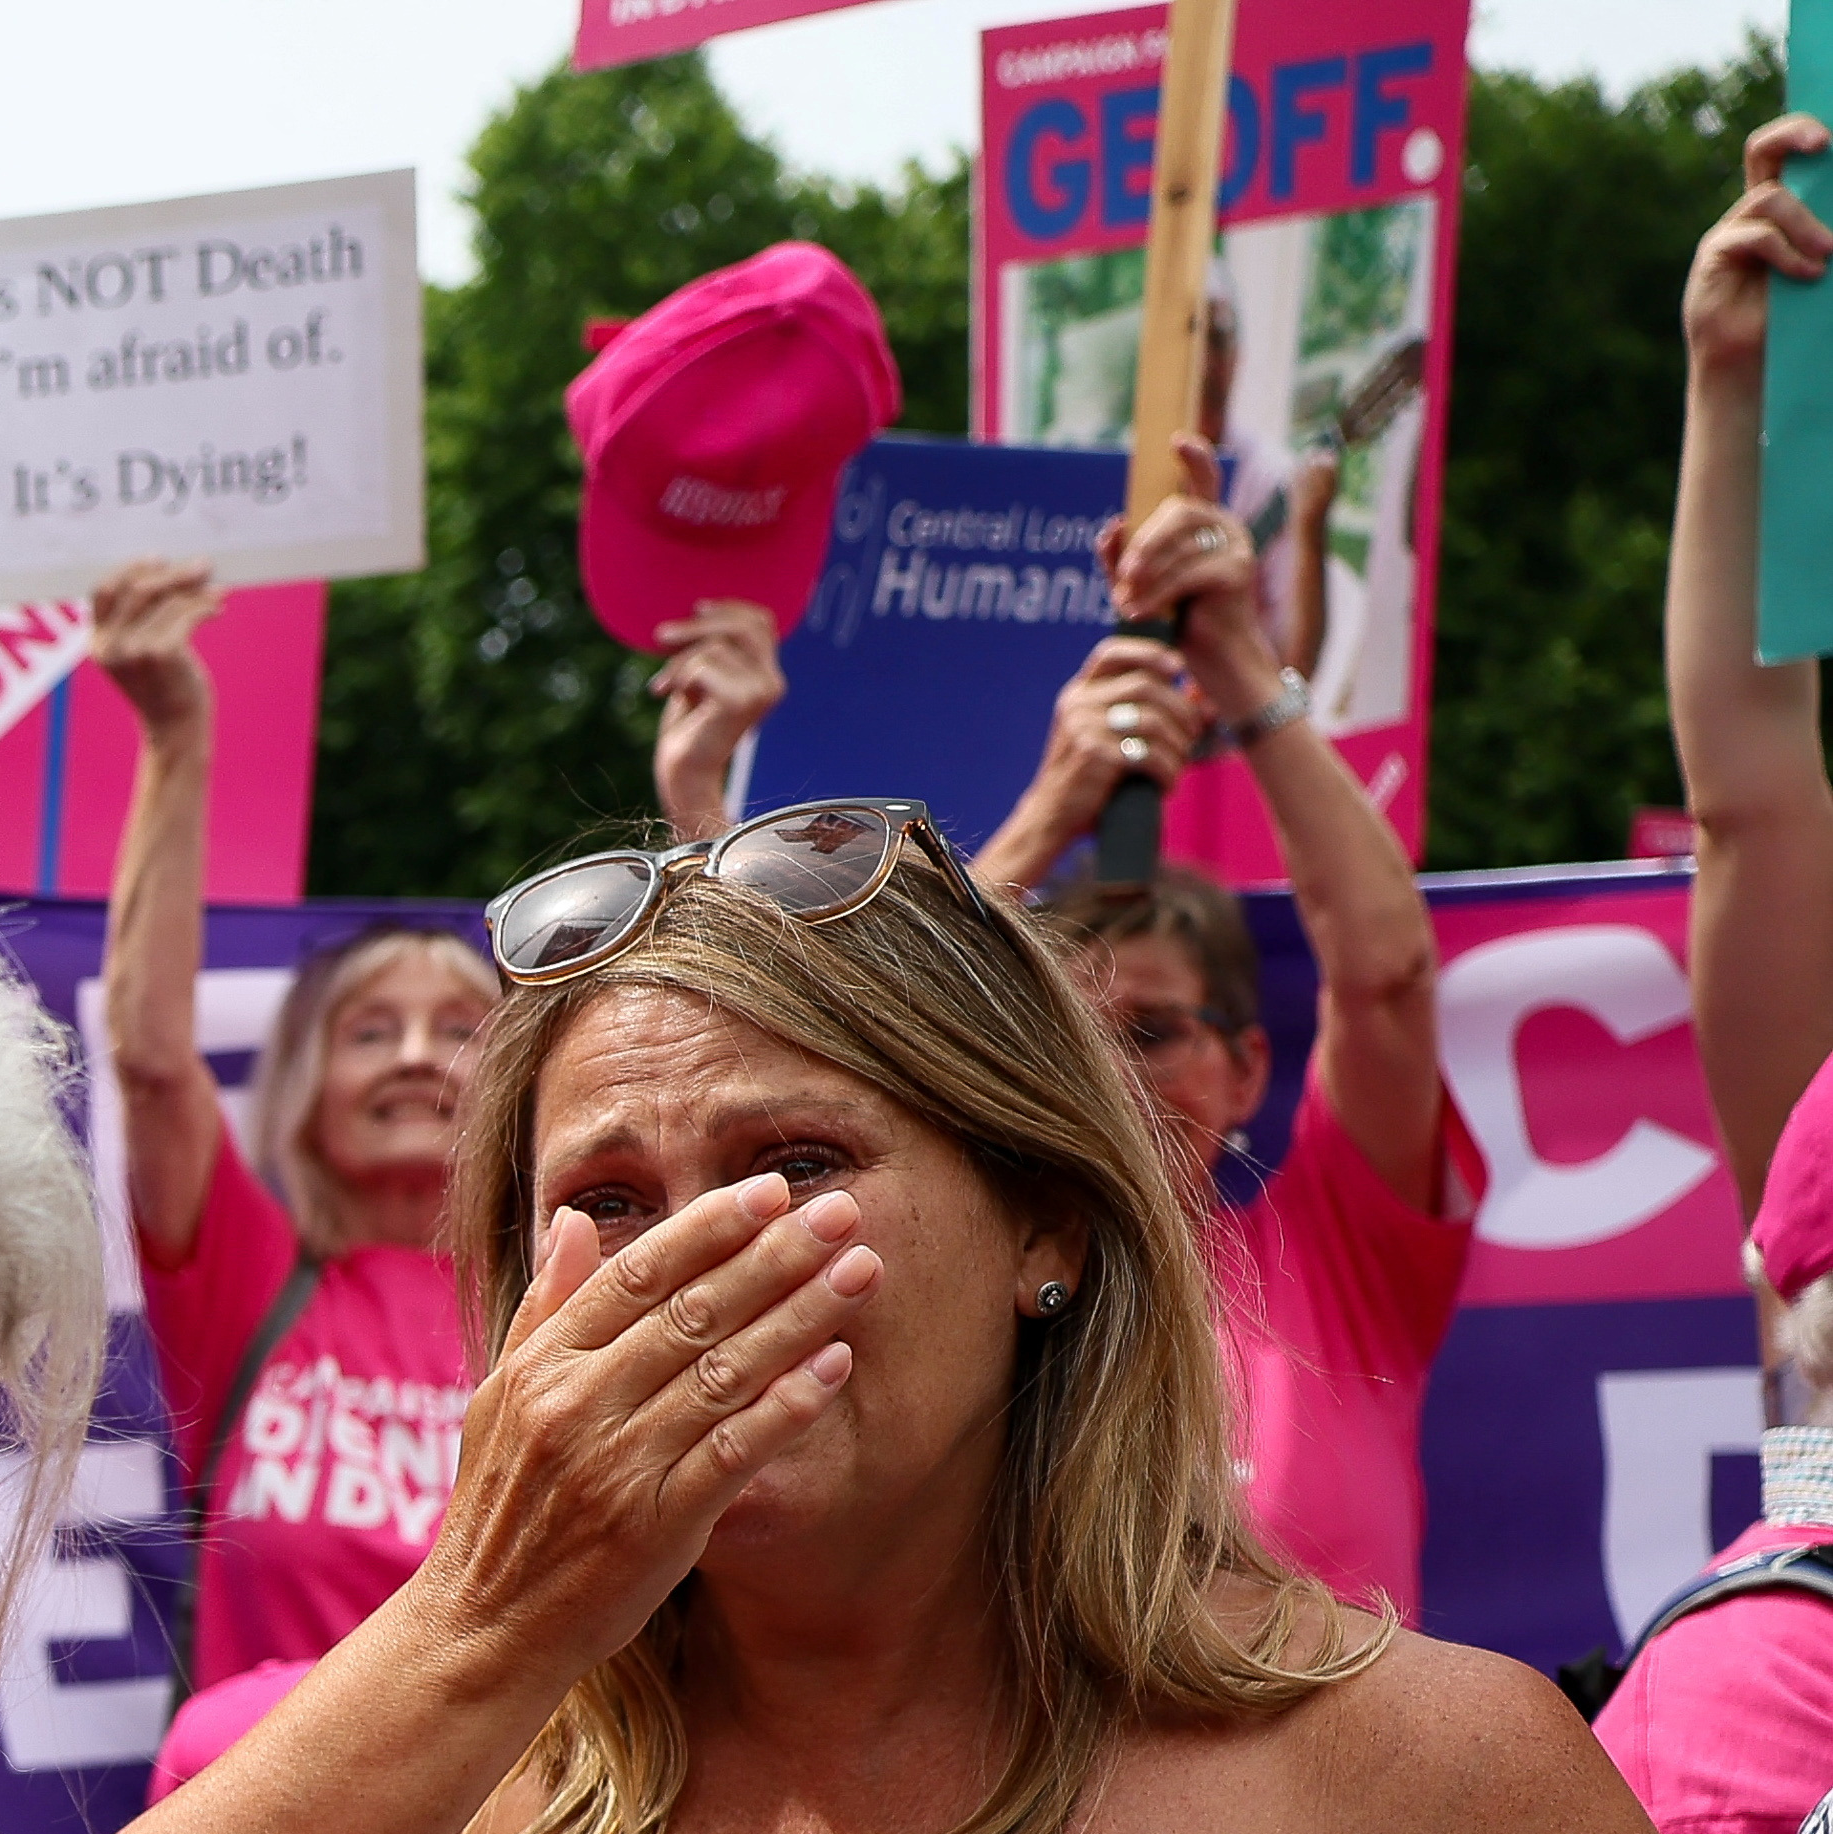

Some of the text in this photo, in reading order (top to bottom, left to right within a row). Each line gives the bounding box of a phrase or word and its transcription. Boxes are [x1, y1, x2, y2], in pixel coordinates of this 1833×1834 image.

[36, 246, 182, 318] NOT
[196, 222, 364, 298] Death
[86, 316, 251, 392] afraid
[13, 430, 310, 518] It's Dying!
[887, 500, 1026, 552] Central
